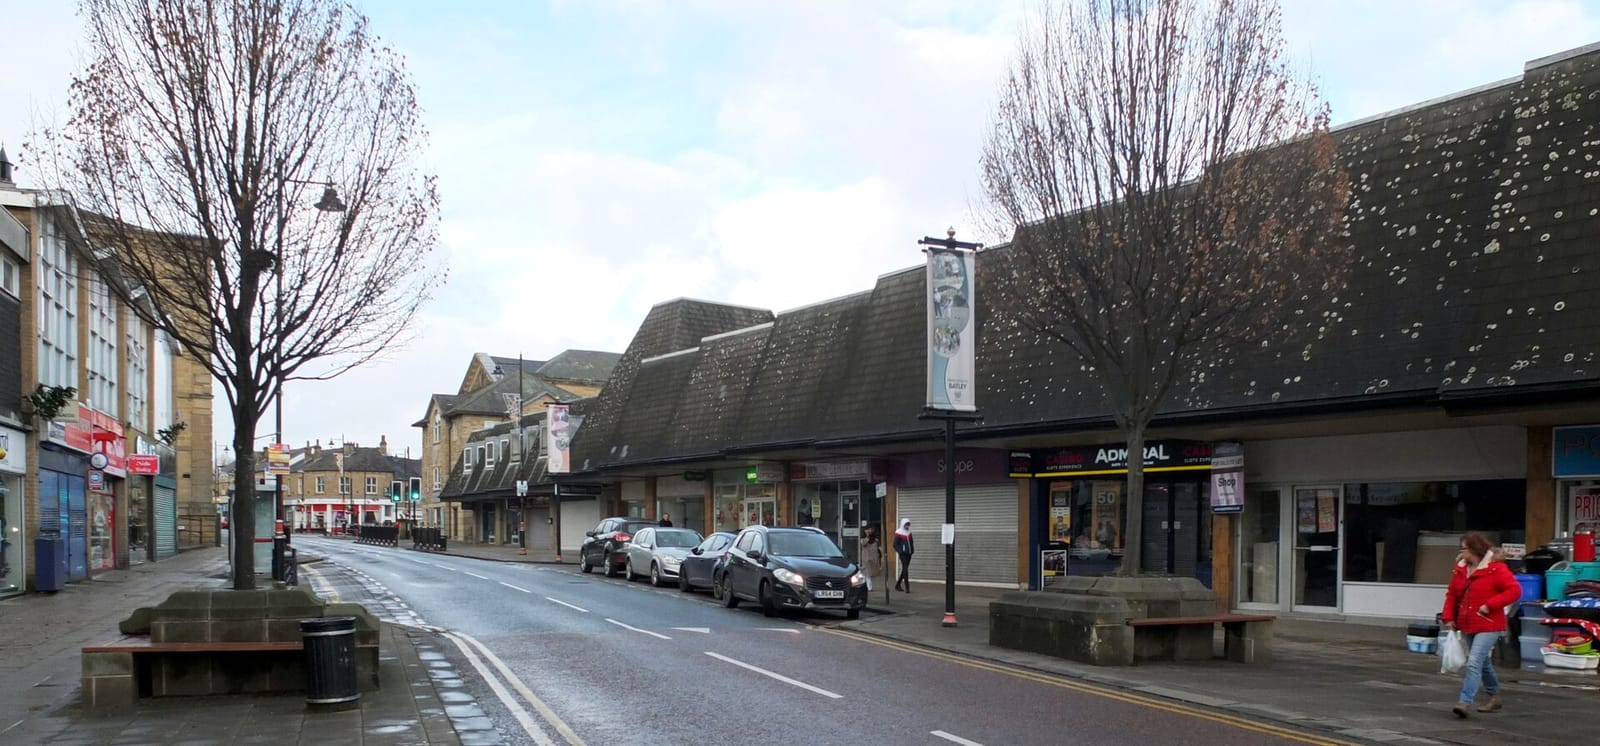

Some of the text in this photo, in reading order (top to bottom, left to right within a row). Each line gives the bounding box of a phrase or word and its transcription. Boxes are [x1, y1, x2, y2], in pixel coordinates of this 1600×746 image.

[1094, 444, 1169, 464] ADMRAL
[1217, 477, 1236, 488] Shop
[1097, 491, 1116, 504] 50
